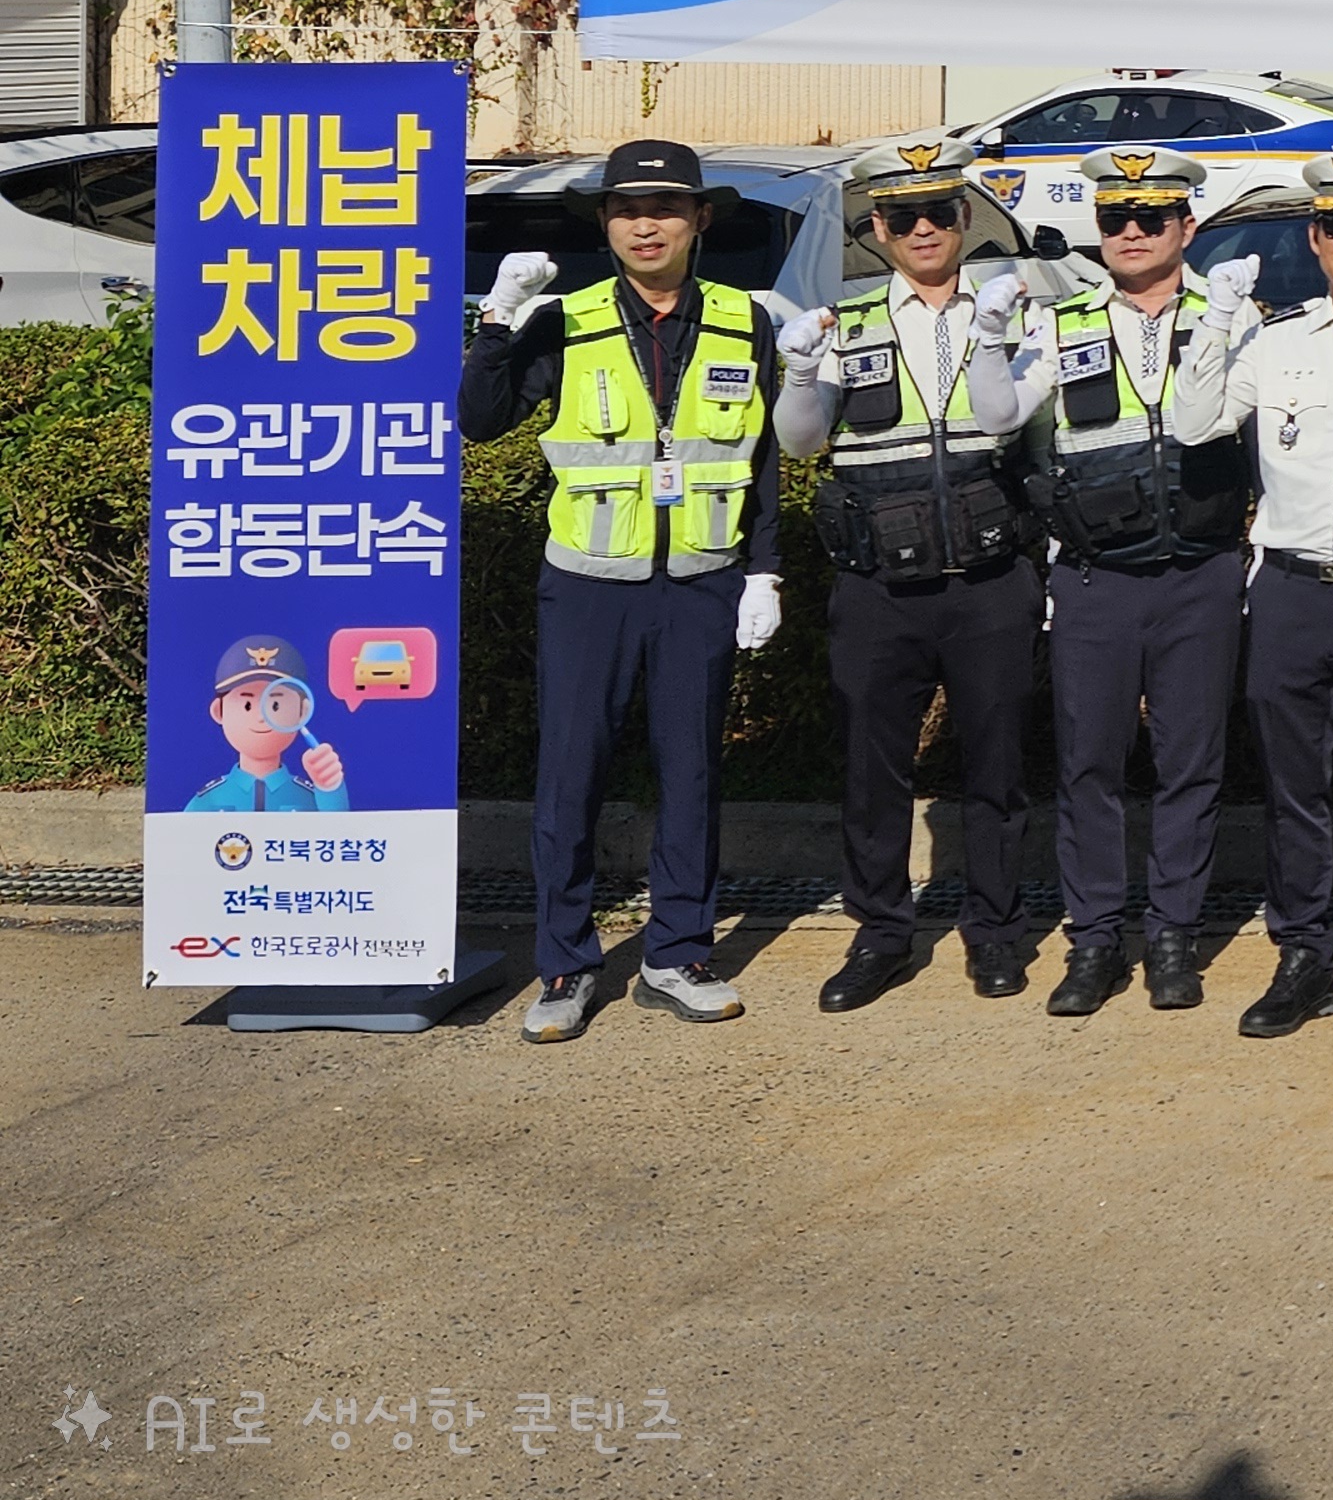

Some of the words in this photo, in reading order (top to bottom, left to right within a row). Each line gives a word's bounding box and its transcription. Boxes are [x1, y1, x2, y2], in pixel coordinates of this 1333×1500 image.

[200, 114, 431, 226] 체납
[1048, 183, 1083, 203] 경찰
[199, 248, 430, 361] 차량
[711, 370, 747, 380] POLICE
[167, 402, 452, 478] 유관기관
[165, 501, 447, 577] 합동단속
[265, 839, 386, 862] 전북경찰청
[224, 885, 374, 914] 전북특별자치도
[252, 937, 358, 957] 한국도로공사
[365, 941, 424, 957] 전북본부
